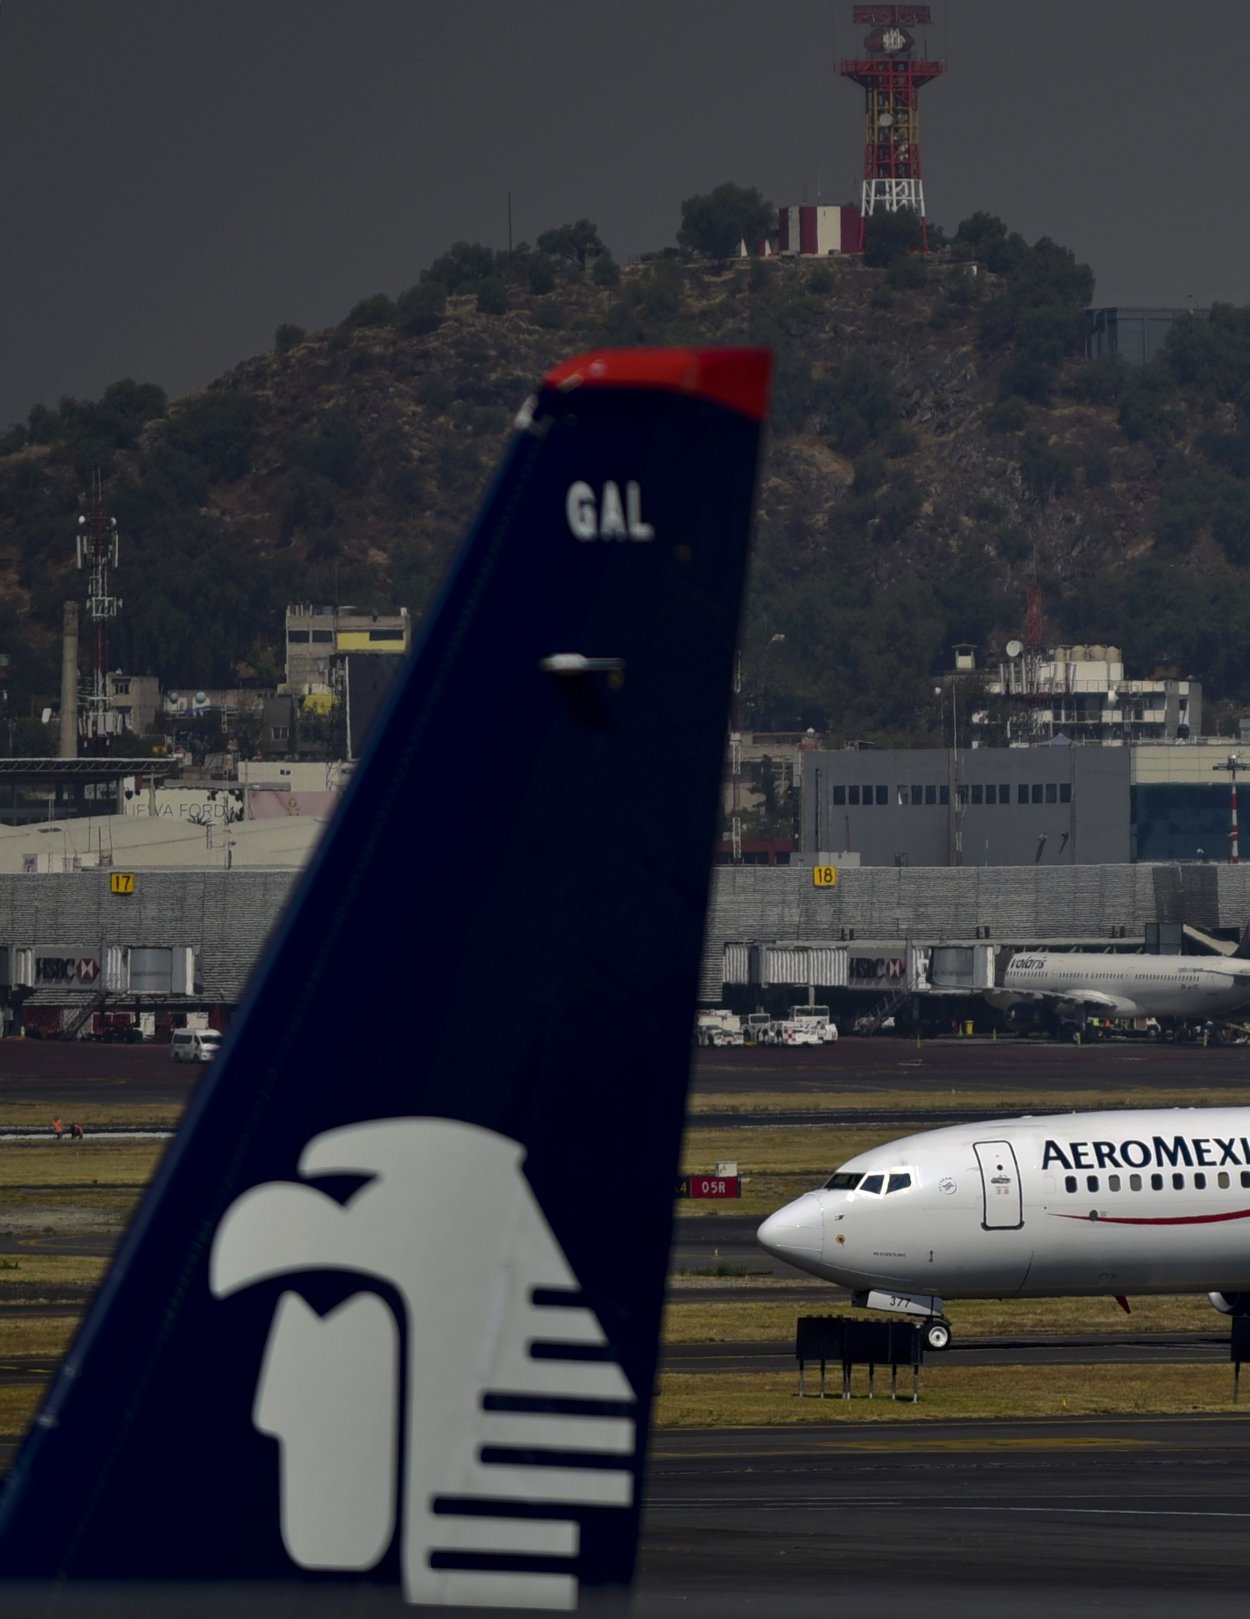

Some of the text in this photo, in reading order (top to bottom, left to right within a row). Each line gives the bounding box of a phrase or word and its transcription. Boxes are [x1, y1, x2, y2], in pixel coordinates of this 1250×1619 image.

[565, 480, 655, 542] GAL
[115, 875, 131, 890] 17
[818, 867, 833, 883] 18
[702, 1181, 726, 1194] 05R
[889, 1296, 911, 1309] 377
